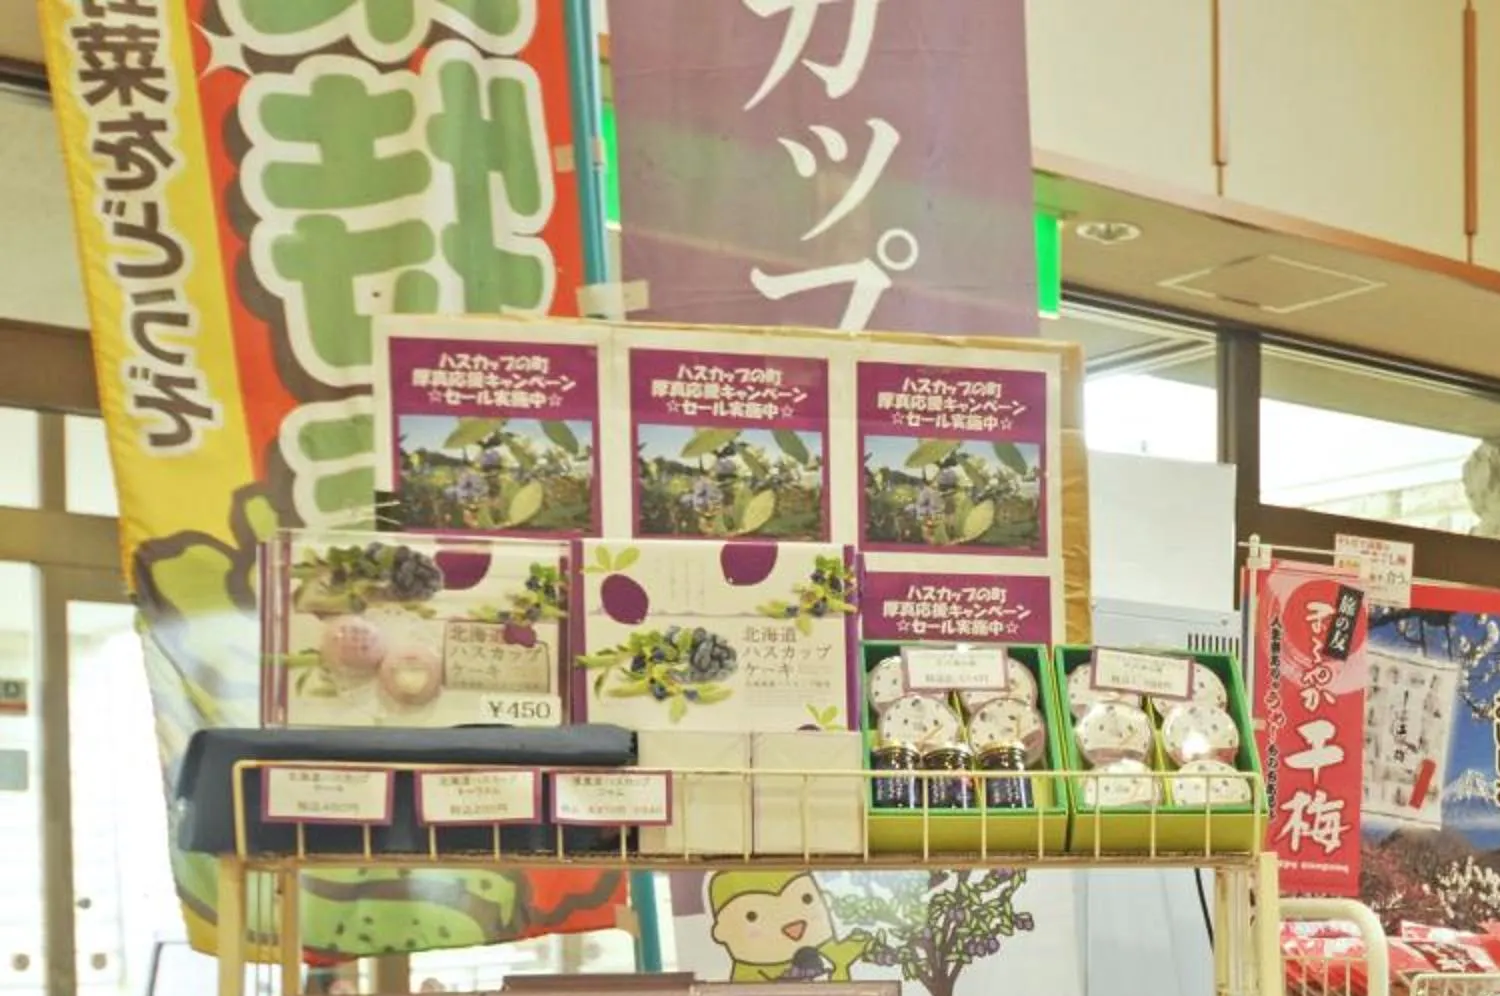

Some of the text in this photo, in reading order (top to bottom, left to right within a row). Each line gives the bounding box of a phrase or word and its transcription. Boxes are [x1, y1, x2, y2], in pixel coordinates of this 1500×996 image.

[742, 626, 797, 643] 北海道
[741, 645, 832, 660] ハスカップ
[489, 701, 551, 719] ¥450
[1282, 720, 1349, 854] 干梅
